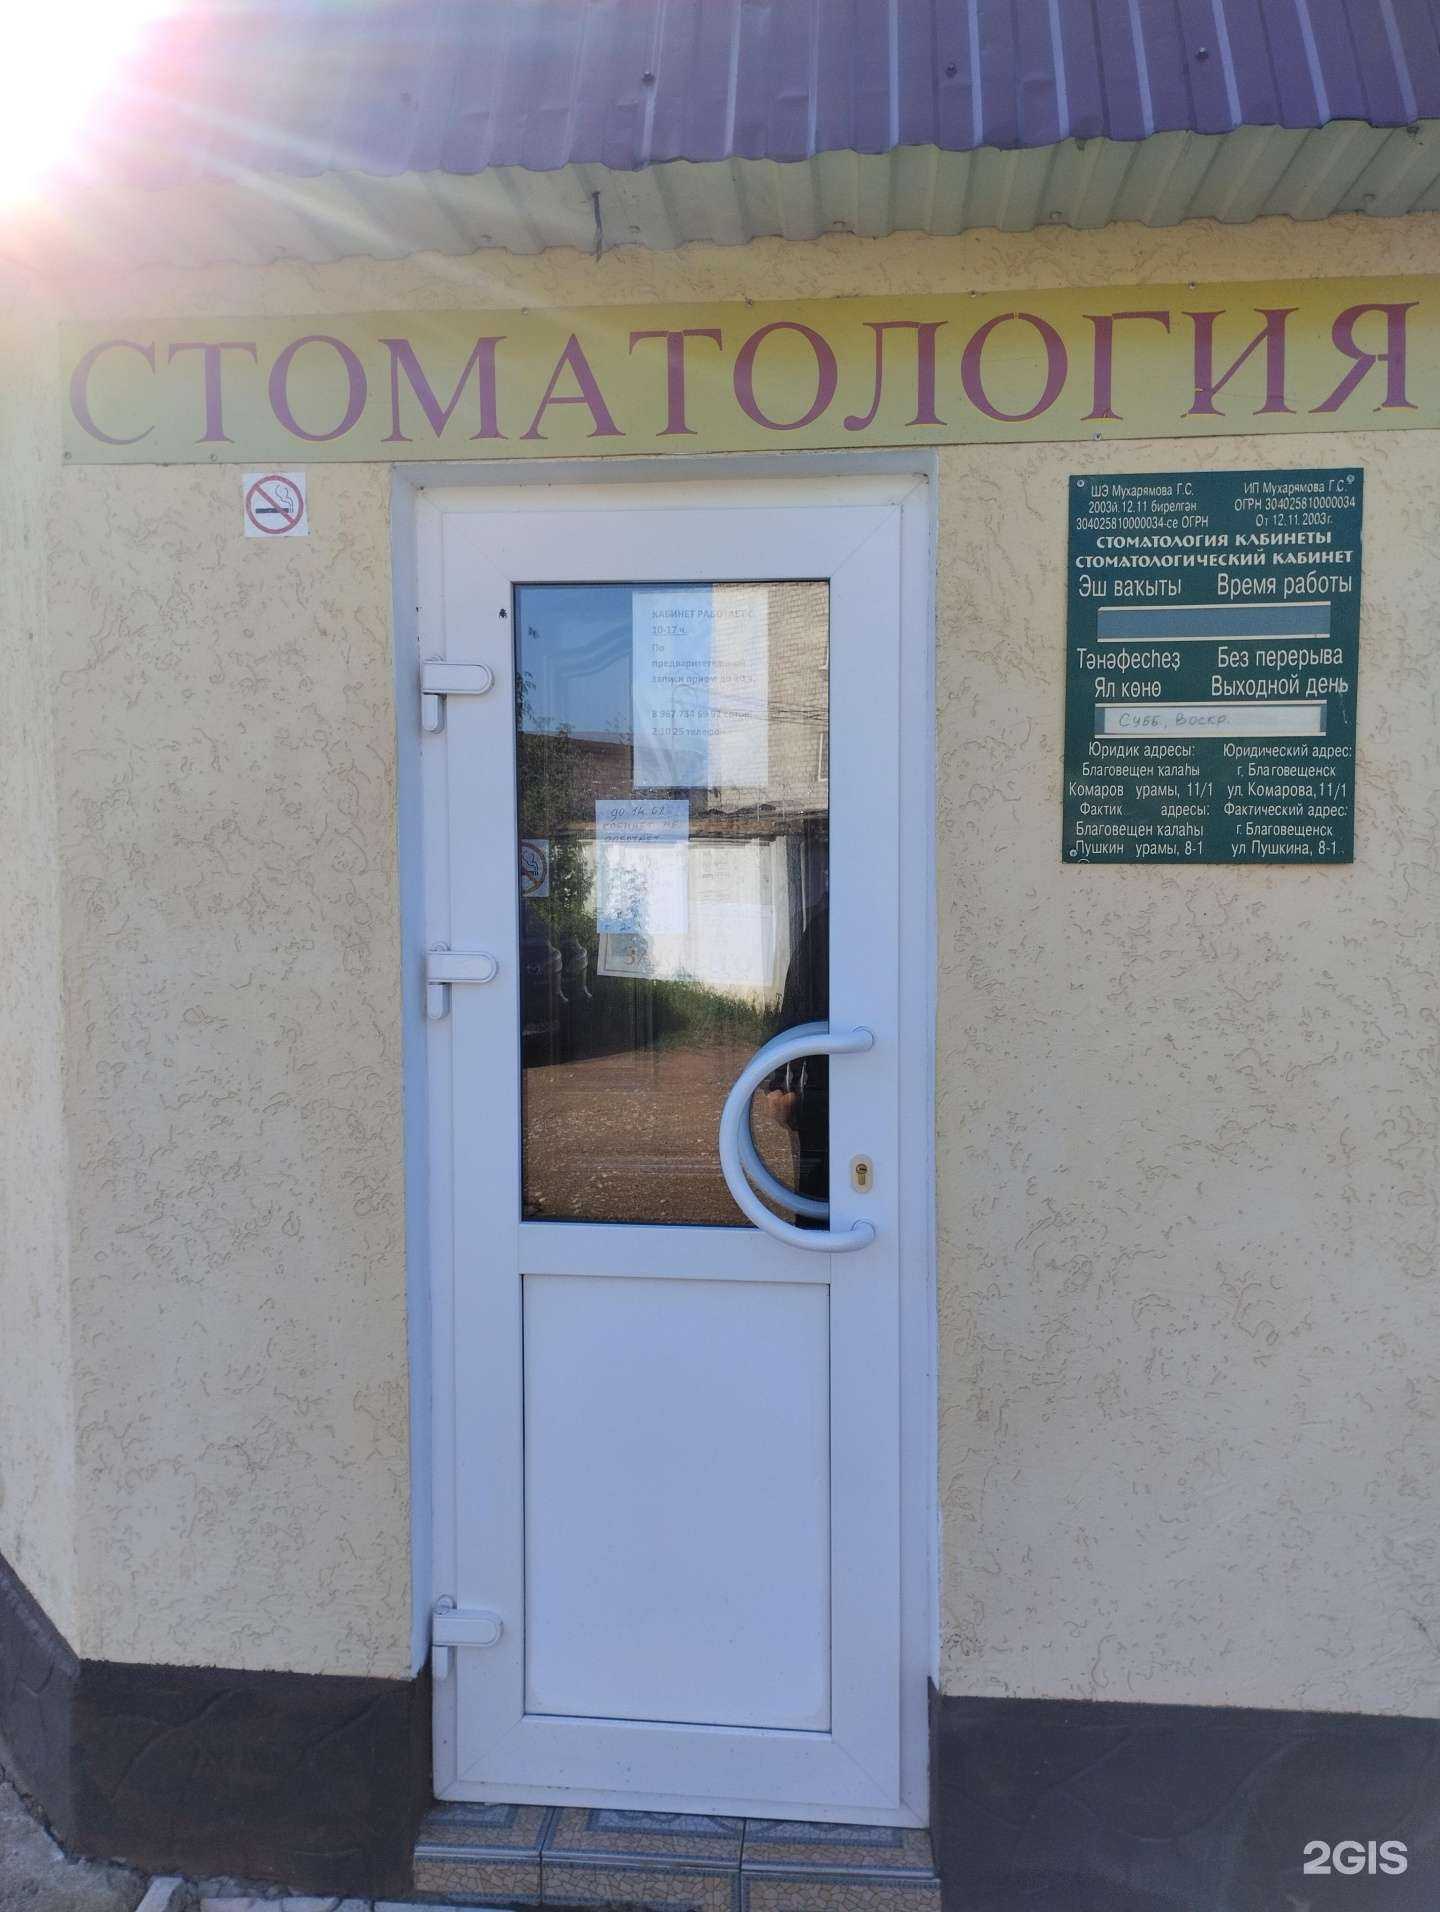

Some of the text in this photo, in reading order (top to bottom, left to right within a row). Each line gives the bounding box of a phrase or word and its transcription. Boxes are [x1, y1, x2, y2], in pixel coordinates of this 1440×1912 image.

[69, 301, 1420, 446] СТОМАТОЛОГИЯ
[1091, 485, 1109, 497] ШЭ
[1112, 485, 1173, 499] Мухарямова
[1244, 482, 1259, 493] ИП
[1262, 482, 1325, 496] Мухарямова
[1234, 498, 1262, 511] ОГРН
[1181, 515, 1209, 528] ОГРН
[1255, 513, 1269, 527] От
[1096, 531, 1332, 549] СТОМАТОЛОГИЯ КАБИНЕТЫ
[1075, 548, 1354, 568] СТОМАТОЛОГИЧЕСКИЙ КАБИНЕТ
[1079, 574, 1107, 597] Эш
[1217, 569, 1352, 600] Время работы
[1218, 646, 1343, 671] Без перерыва
[1094, 676, 1162, 698] Ял көнө
[1211, 673, 1349, 698] Выходной день
[1088, 741, 1196, 759] Юридик адресы:
[1223, 742, 1352, 760] Юридический адрес:
[1082, 762, 1154, 778] Благовещен
[1248, 762, 1336, 780] Благовещенск
[1069, 781, 1213, 800] Комаров урамы, 11/1
[1319, 782, 1347, 801] 11/1
[1079, 801, 1210, 819] Фактик адресы:
[1223, 802, 1348, 819] Фактический адрес:
[1076, 821, 1153, 838] Благовещен
[1246, 822, 1333, 837] Благовещенск
[1076, 839, 1203, 858] Пушкин урамы, 8-1
[1251, 840, 1313, 857] Пушкина,
[1318, 840, 1337, 855] 8-1
